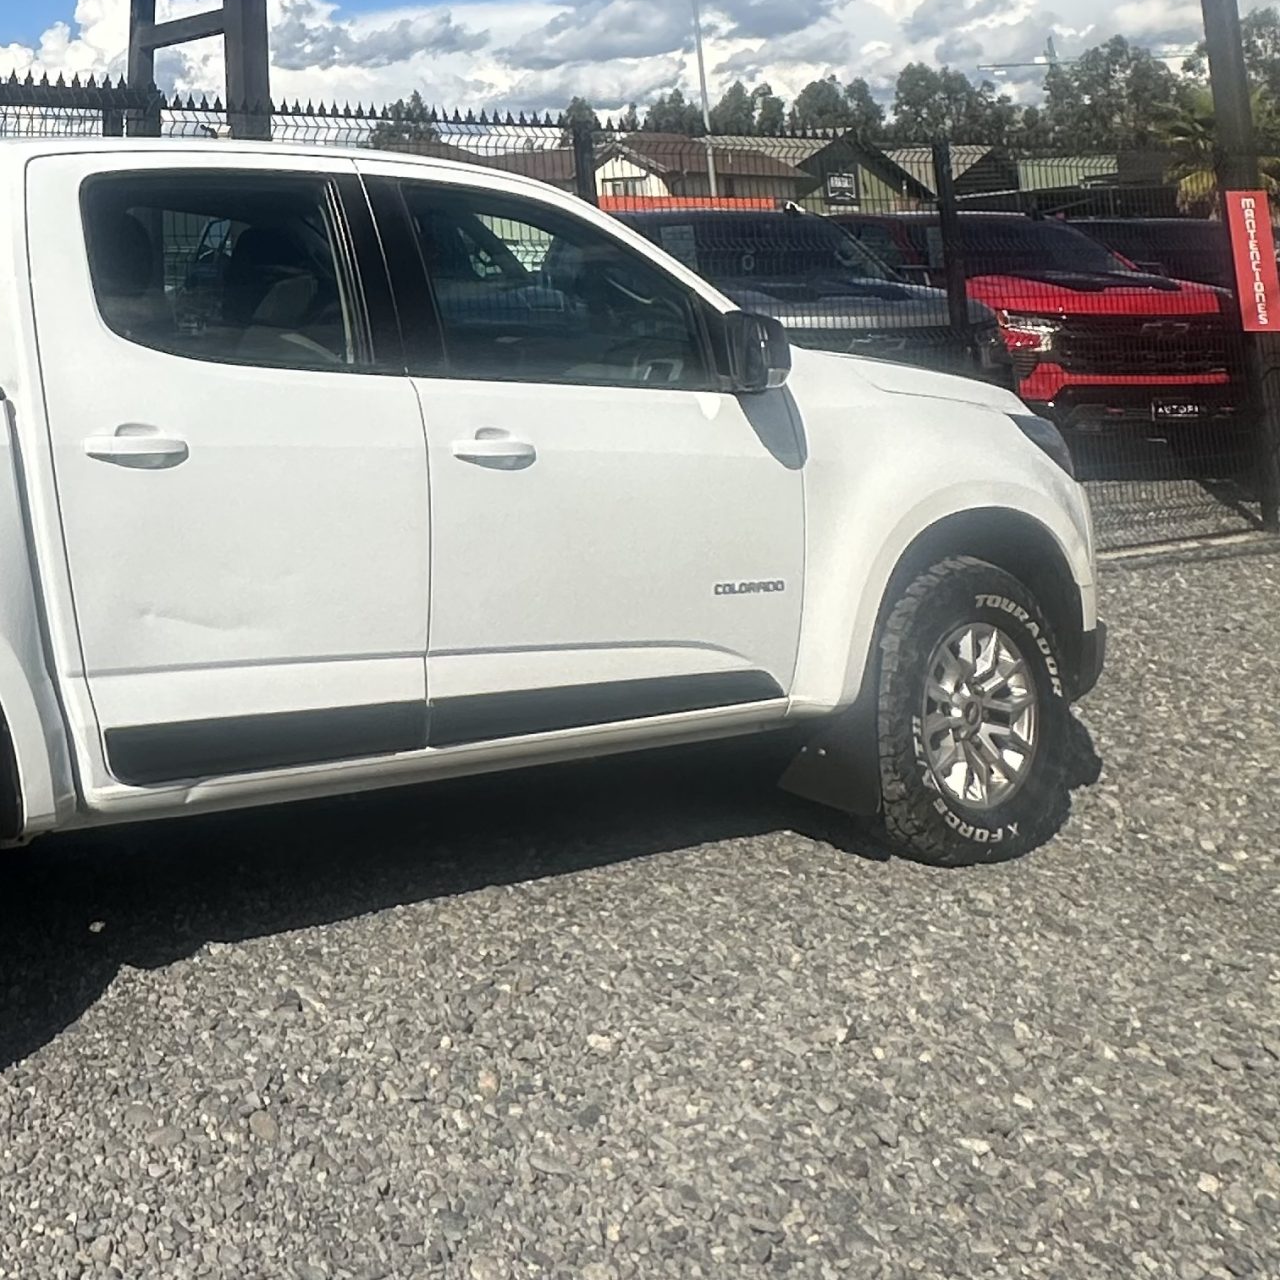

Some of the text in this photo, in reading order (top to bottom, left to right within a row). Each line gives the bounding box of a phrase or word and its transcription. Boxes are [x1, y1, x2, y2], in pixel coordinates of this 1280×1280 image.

[1241, 198, 1269, 325] MANTENCIONES
[714, 580, 785, 595] COLORADO
[975, 594, 1063, 698] TOURADOR
[933, 798, 1003, 842] FORCE
